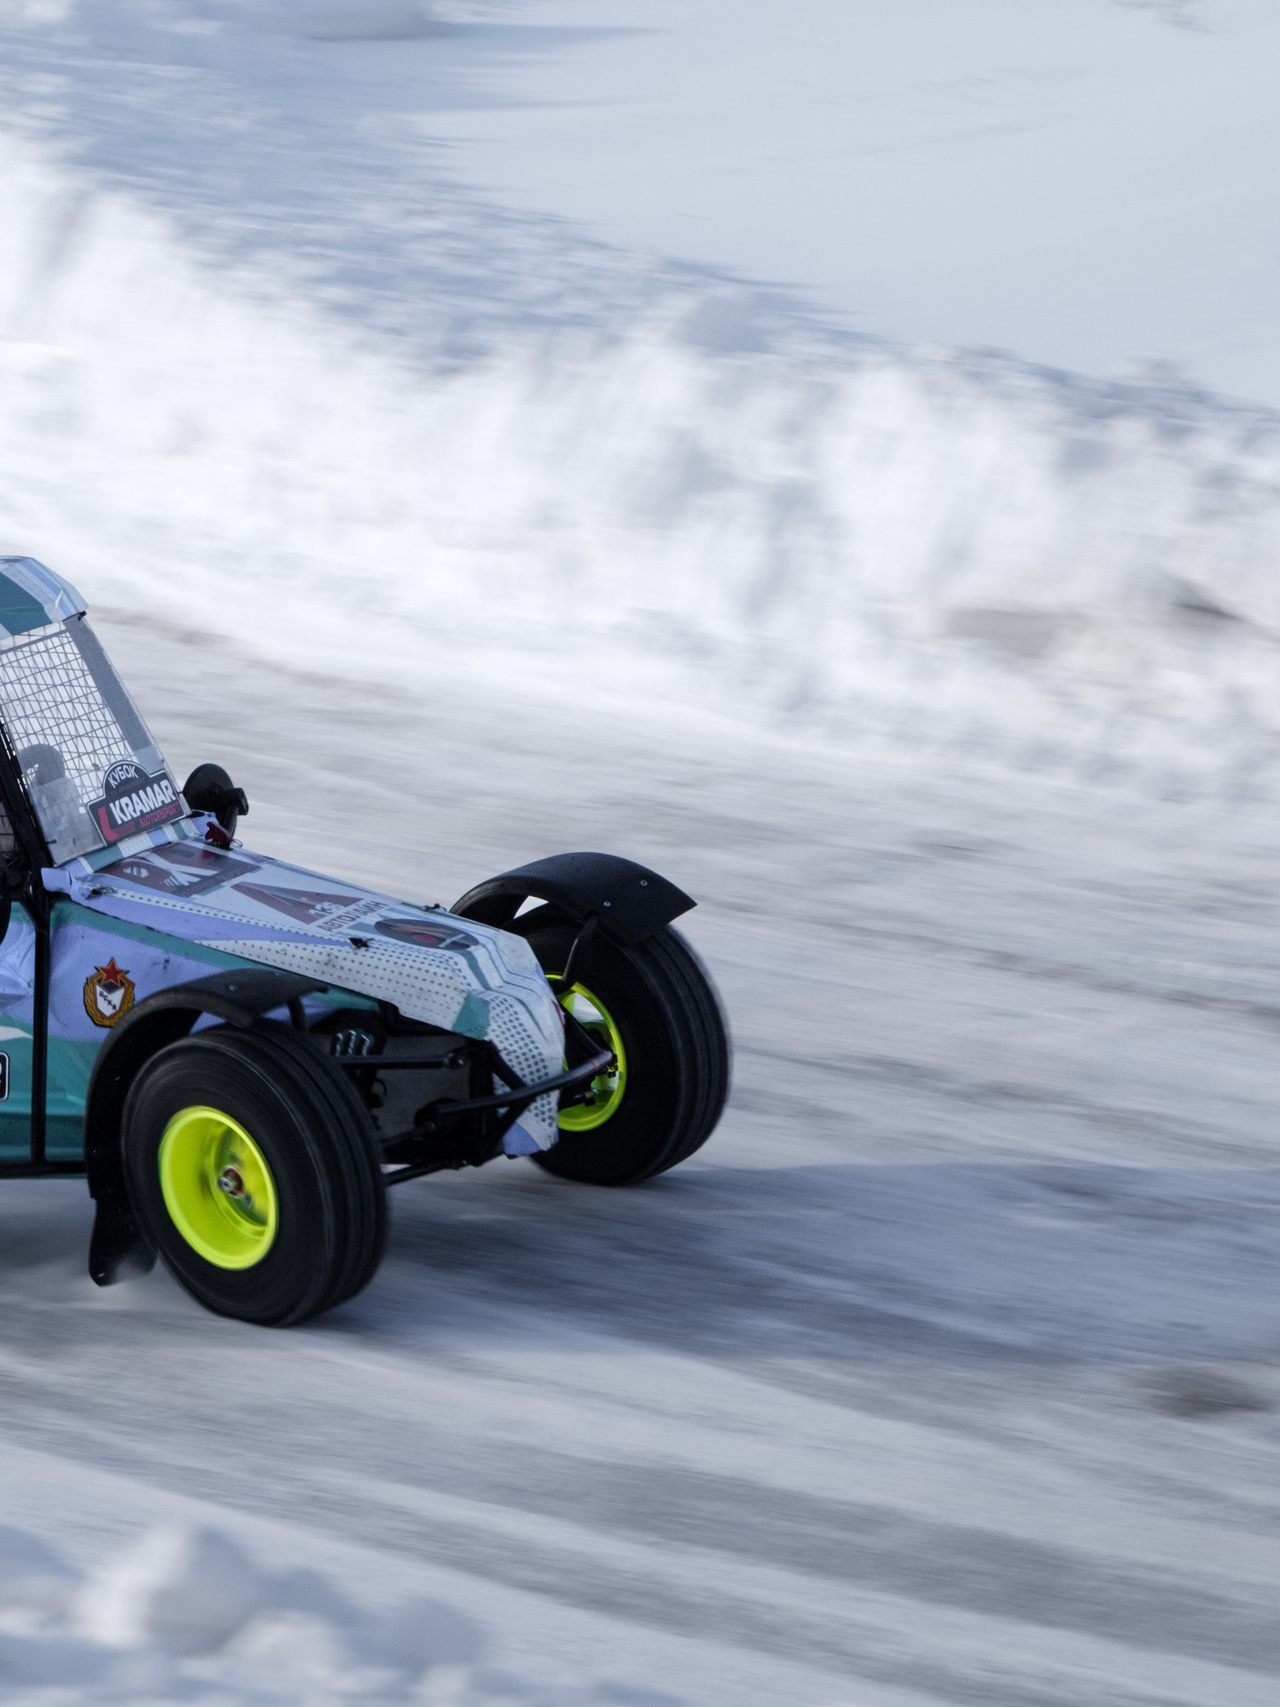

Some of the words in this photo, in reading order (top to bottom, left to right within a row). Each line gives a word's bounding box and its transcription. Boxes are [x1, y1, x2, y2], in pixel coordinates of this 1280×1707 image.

[108, 765, 138, 788] КУБОК
[110, 779, 176, 825] KRAMAR
[140, 802, 179, 828] MOTORSPORT
